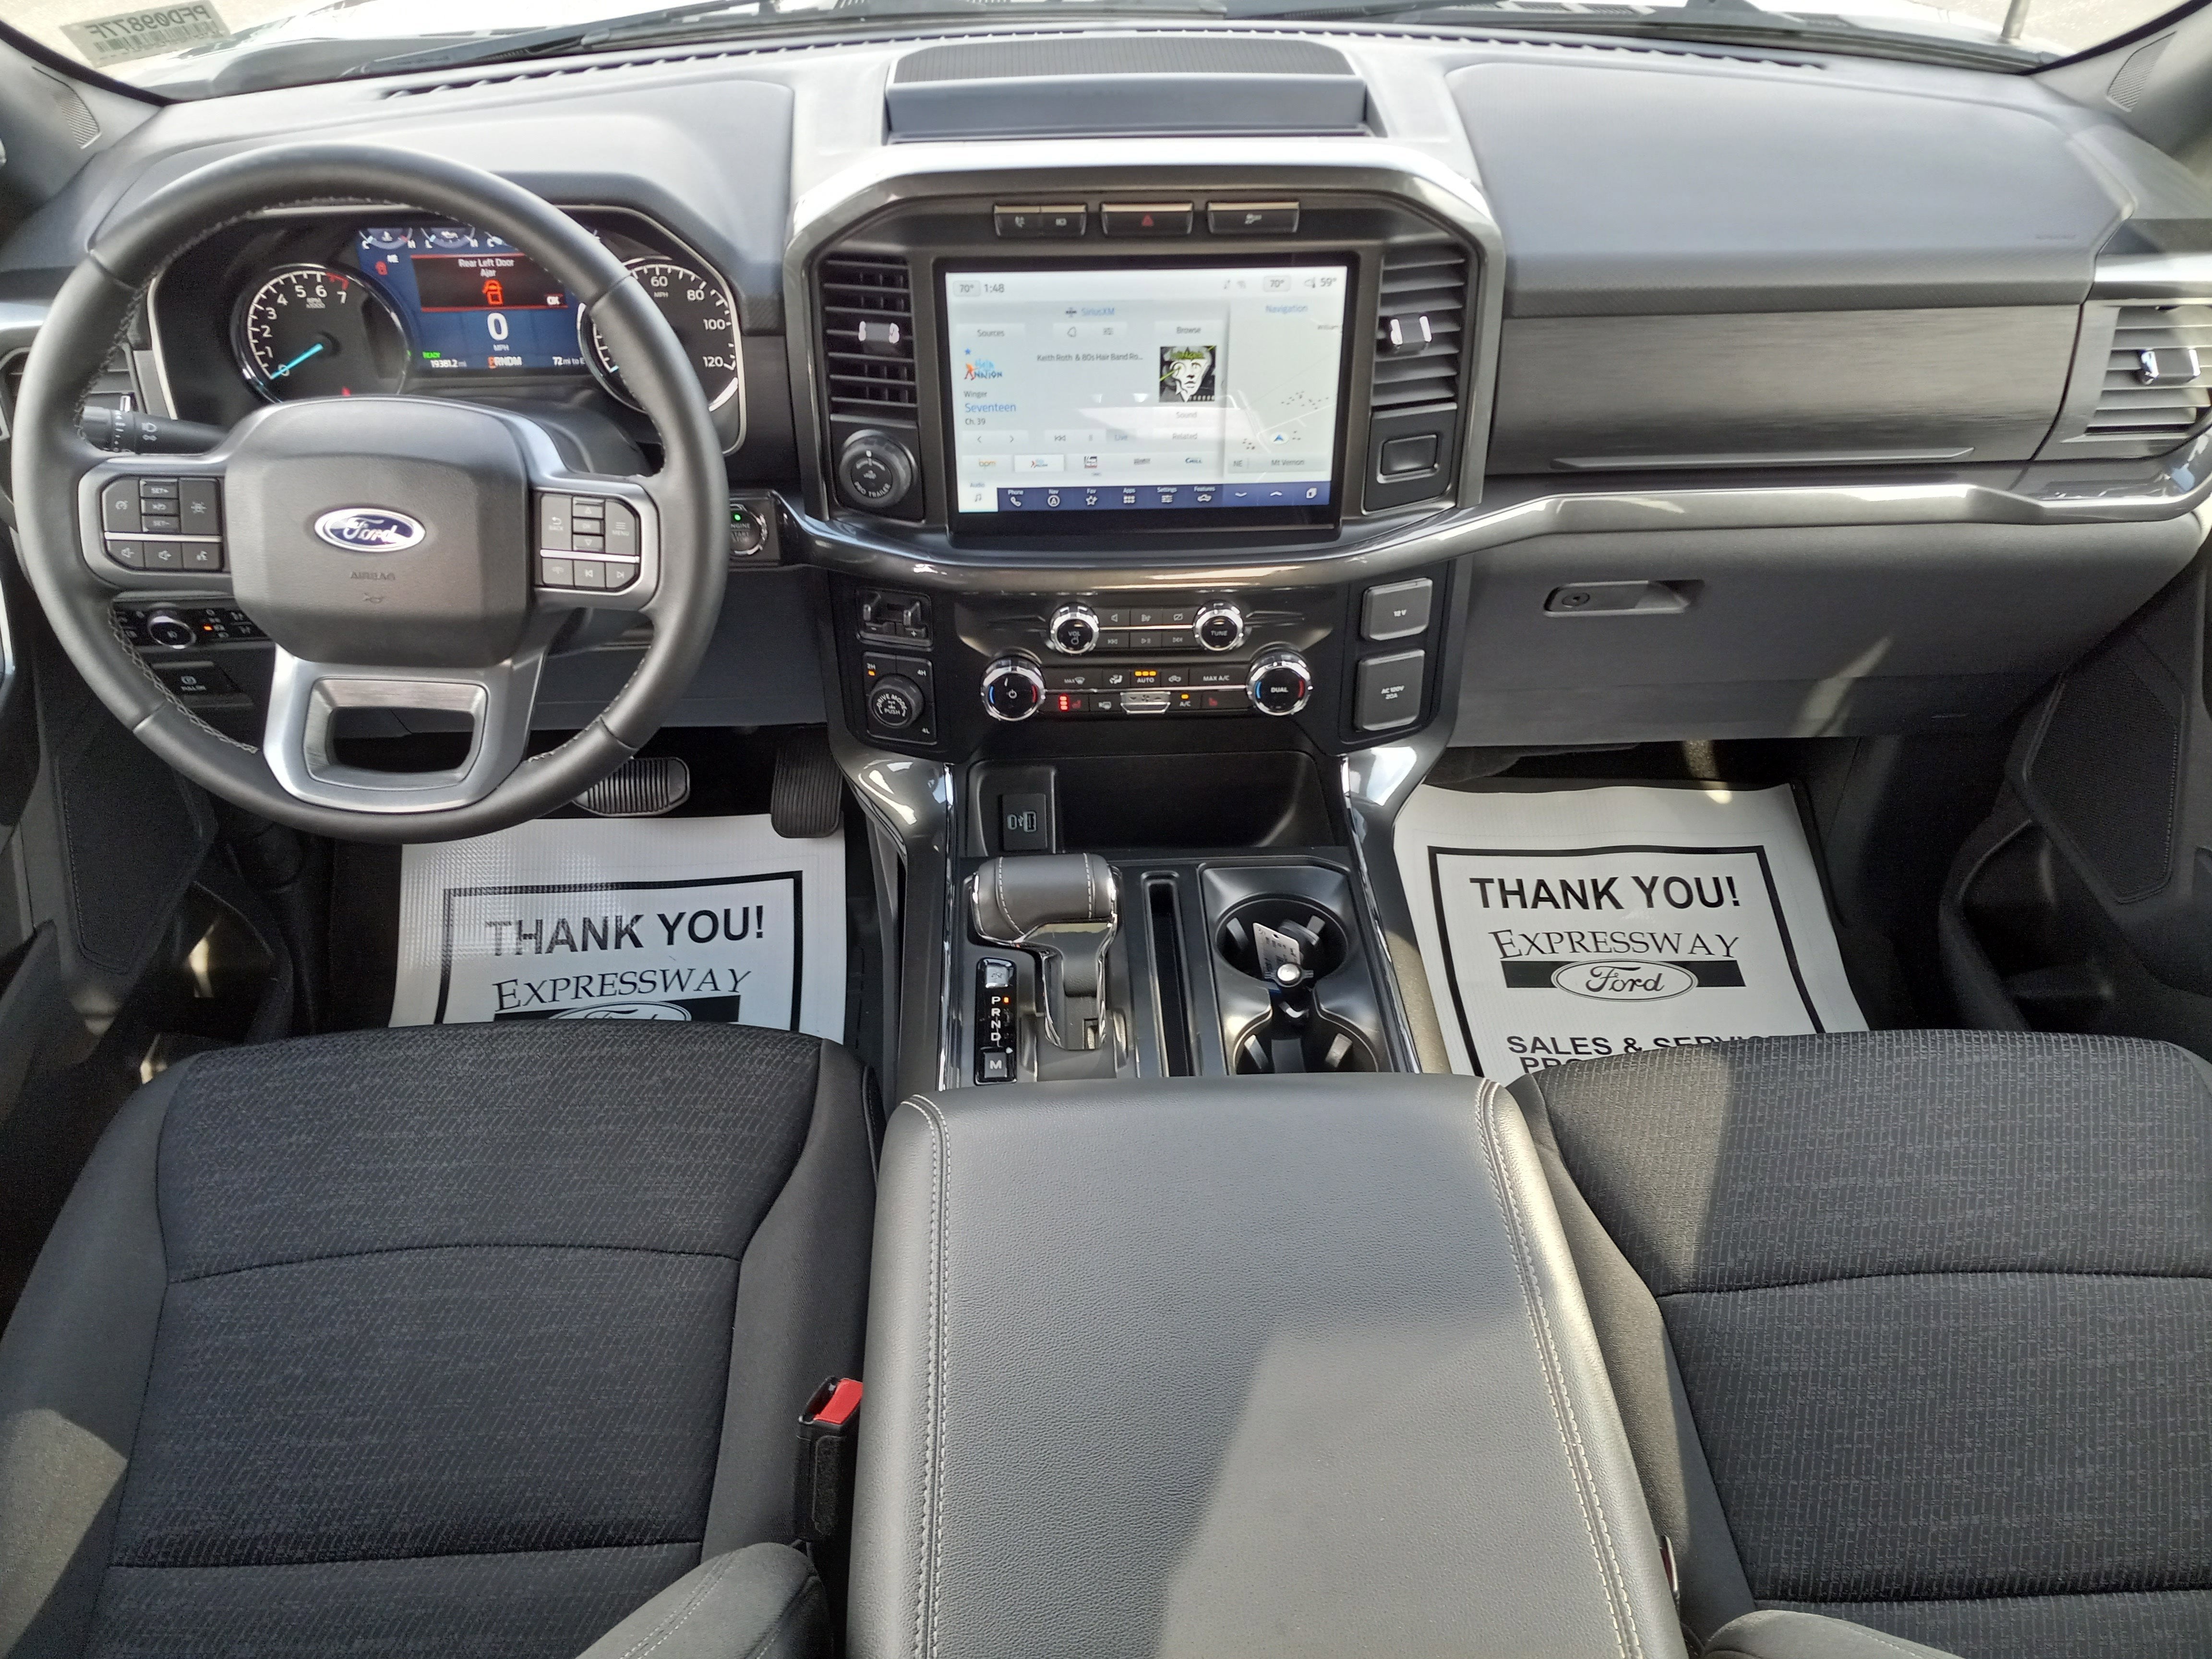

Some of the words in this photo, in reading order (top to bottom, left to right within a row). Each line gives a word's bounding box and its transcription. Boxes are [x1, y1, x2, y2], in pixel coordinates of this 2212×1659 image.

[458, 259, 477, 267] Rear
[478, 258, 494, 267] Left
[495, 258, 514, 267] Door
[481, 268, 496, 277] Ajar
[650, 276, 668, 287] 60
[295, 285, 307, 298] 5
[316, 285, 327, 297] 6
[984, 284, 1004, 293] 1:48
[277, 293, 288, 306] 4
[337, 291, 347, 304] 7
[547, 296, 559, 305] OK
[687, 289, 705, 301] 80
[266, 307, 277, 320] 3
[1266, 305, 1308, 314] Navigation
[487, 313, 509, 340] 0
[703, 318, 725, 330] 100
[261, 325, 273, 337] 2
[265, 346, 273, 358] 1
[703, 356, 723, 367] 120
[963, 390, 987, 398] Winger
[965, 402, 1017, 412] Seventeen
[979, 458, 996, 470] bpm
[854, 481, 866, 495] PRO
[868, 483, 891, 498] TRAILER
[342, 517, 404, 543] Ford
[877, 693, 890, 707] DRIVE
[891, 694, 907, 710] MODE
[1469, 877, 1625, 910] THANK
[1631, 876, 1741, 909] YOU!
[485, 914, 644, 956] THANK
[657, 905, 764, 946] YOU!
[1488, 929, 1740, 960] EXPRESSWAY
[1585, 966, 1665, 993] Ford
[493, 968, 752, 1012] EXPRESSWAY
[991, 996, 1001, 1005] P
[991, 1008, 1001, 1017] R
[991, 1020, 1001, 1029] N
[991, 1032, 1001, 1042] D
[1506, 1036, 1613, 1056] SALES
[1623, 1037, 1643, 1053] &
[990, 1060, 1002, 1070] M
